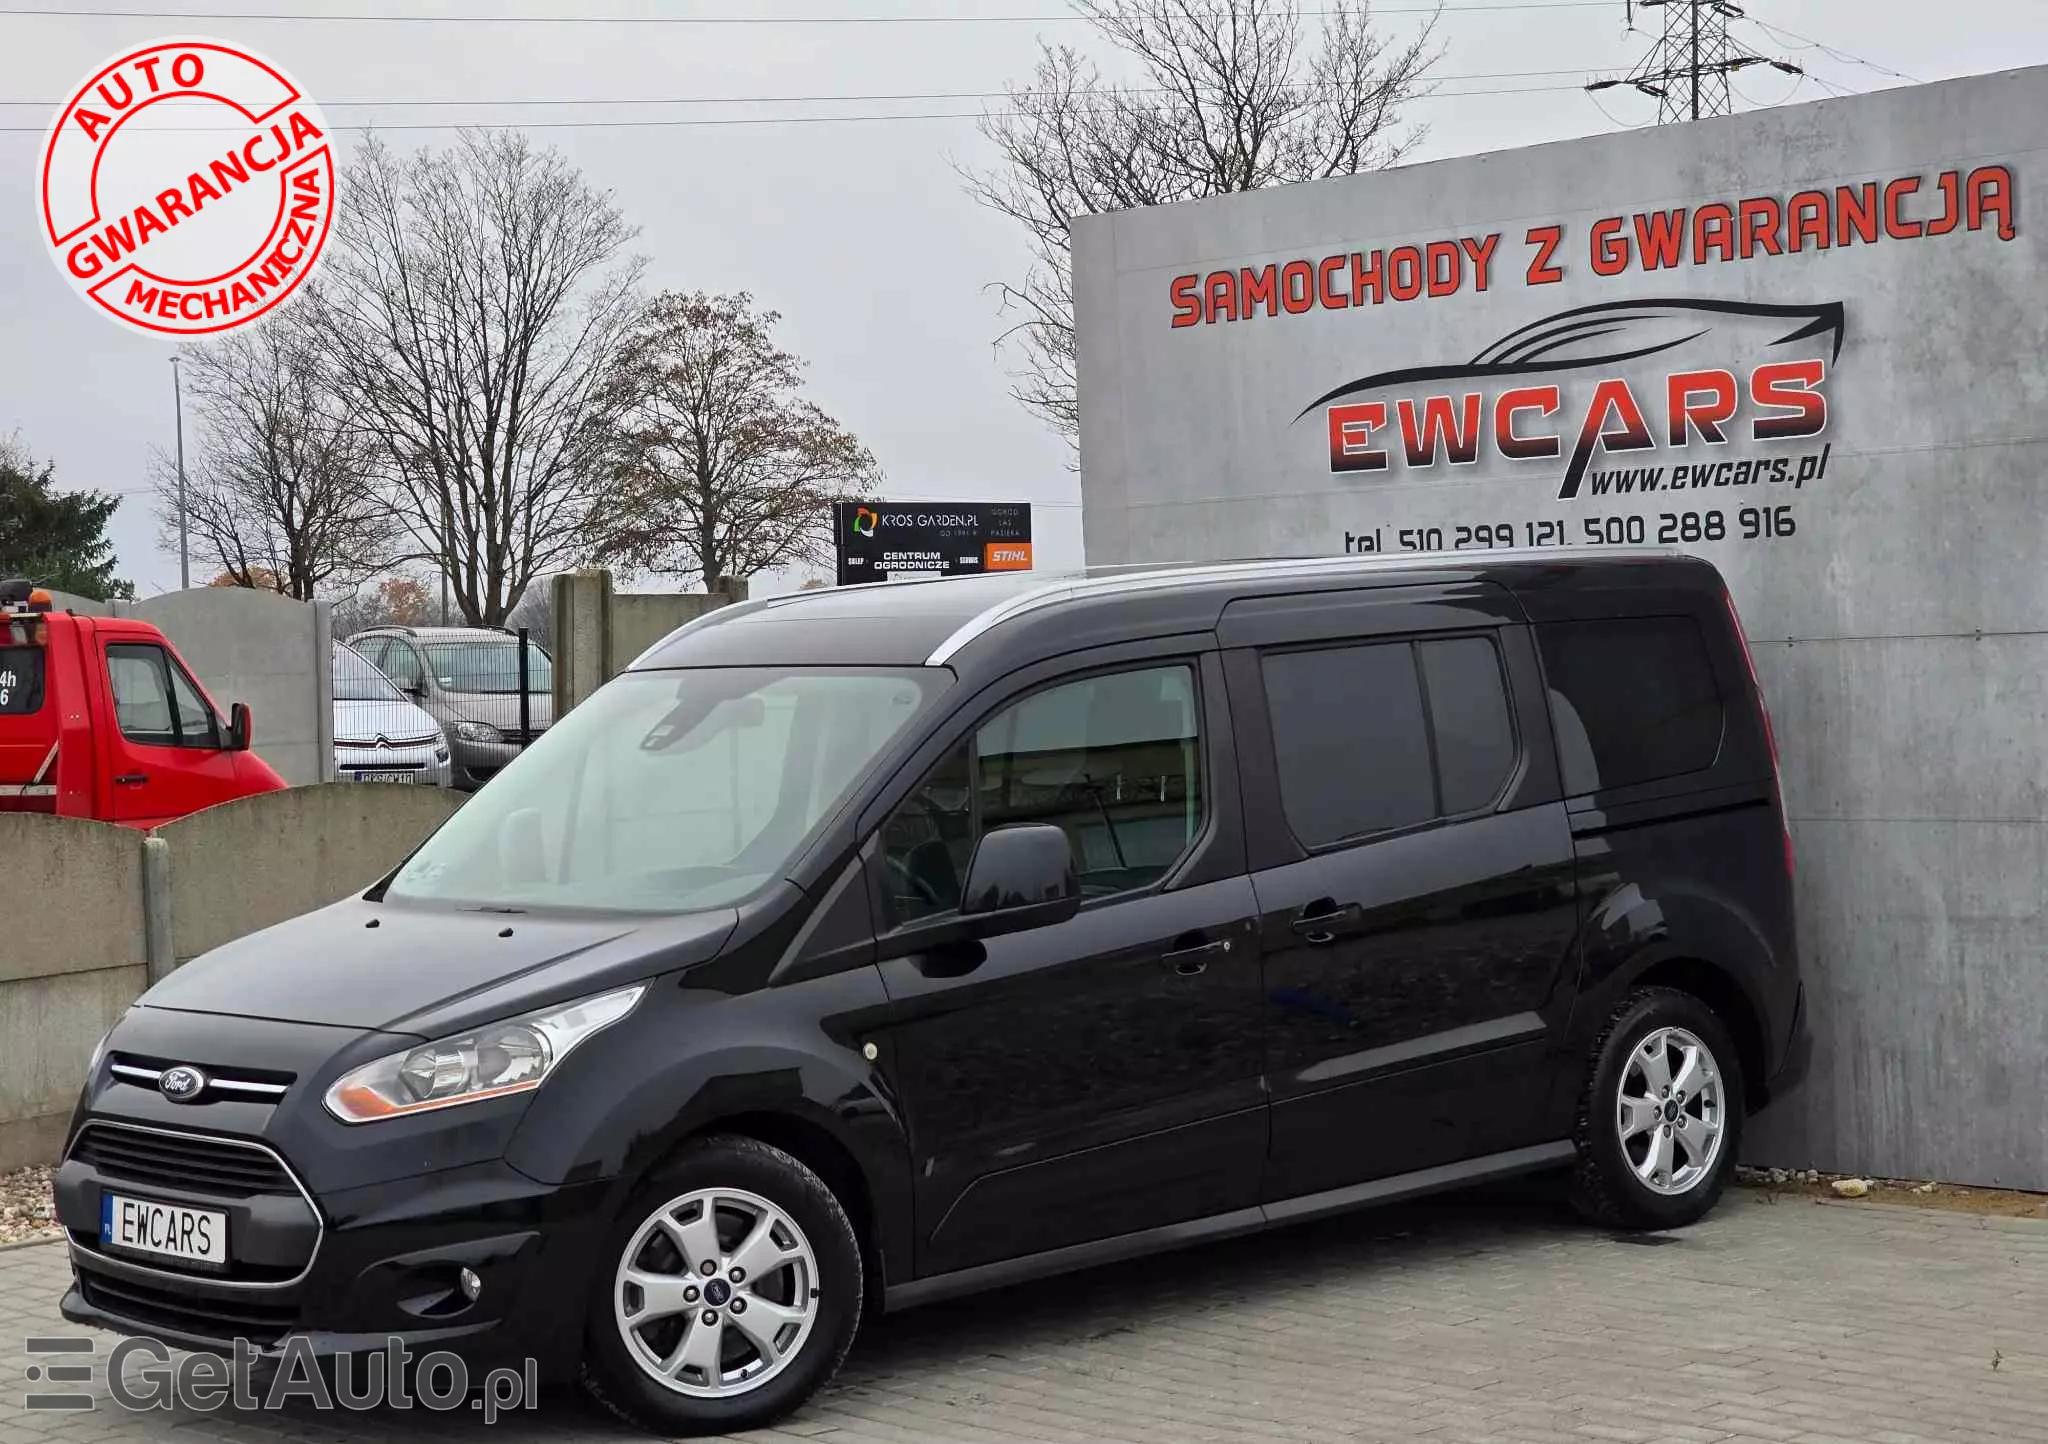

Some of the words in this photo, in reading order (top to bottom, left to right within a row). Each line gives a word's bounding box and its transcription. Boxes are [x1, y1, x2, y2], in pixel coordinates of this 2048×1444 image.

[1169, 232, 1502, 329] SAMOCHODY
[1524, 224, 1563, 287] Z
[1589, 165, 2016, 277] GWARANCJĄ
[1326, 358, 1828, 502] EWCARS
[1590, 442, 1832, 496] www.ewcars.pl
[881, 514, 913, 527] KROS
[917, 514, 979, 527] GARDEN.PL
[1399, 527, 1443, 551] 510
[1454, 523, 1514, 549] 299
[1584, 515, 1645, 545] 500
[1658, 509, 1726, 545] 288
[1738, 505, 1796, 540] 916
[873, 561, 950, 570] OGRODNICZE
[883, 551, 941, 561] CENTRUM
[991, 549, 1028, 562] STIHL
[164, 1071, 191, 1092] Ford
[122, 1202, 211, 1255] EWCARS
